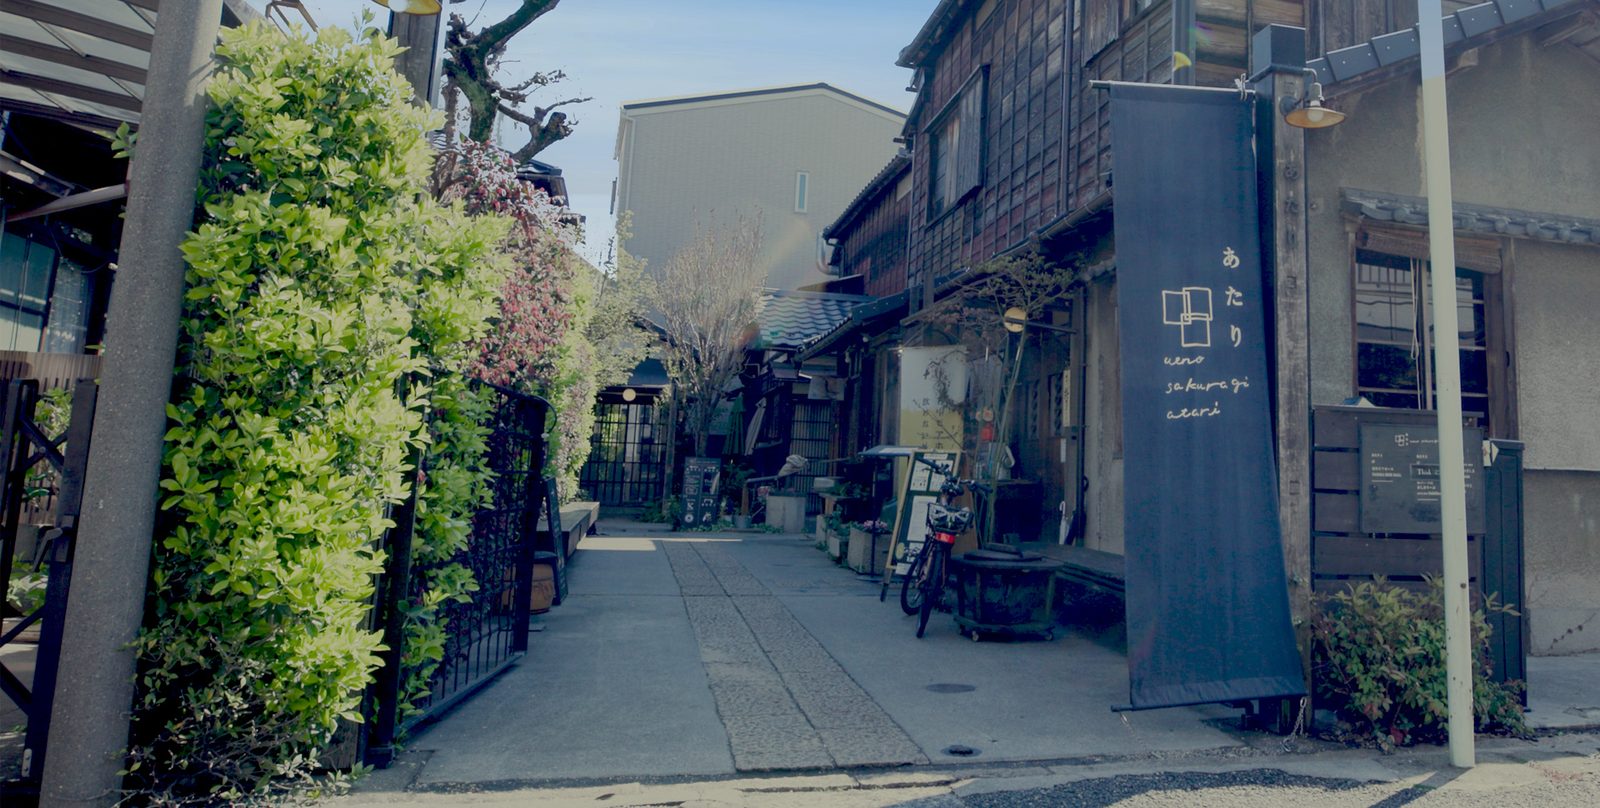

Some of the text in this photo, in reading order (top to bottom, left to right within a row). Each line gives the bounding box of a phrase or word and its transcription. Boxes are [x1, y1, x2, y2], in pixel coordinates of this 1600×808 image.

[1223, 247, 1243, 347] あたり
[1164, 355, 1205, 365] ueno
[1165, 376, 1249, 394] sakuragi
[1167, 401, 1220, 419] atari
